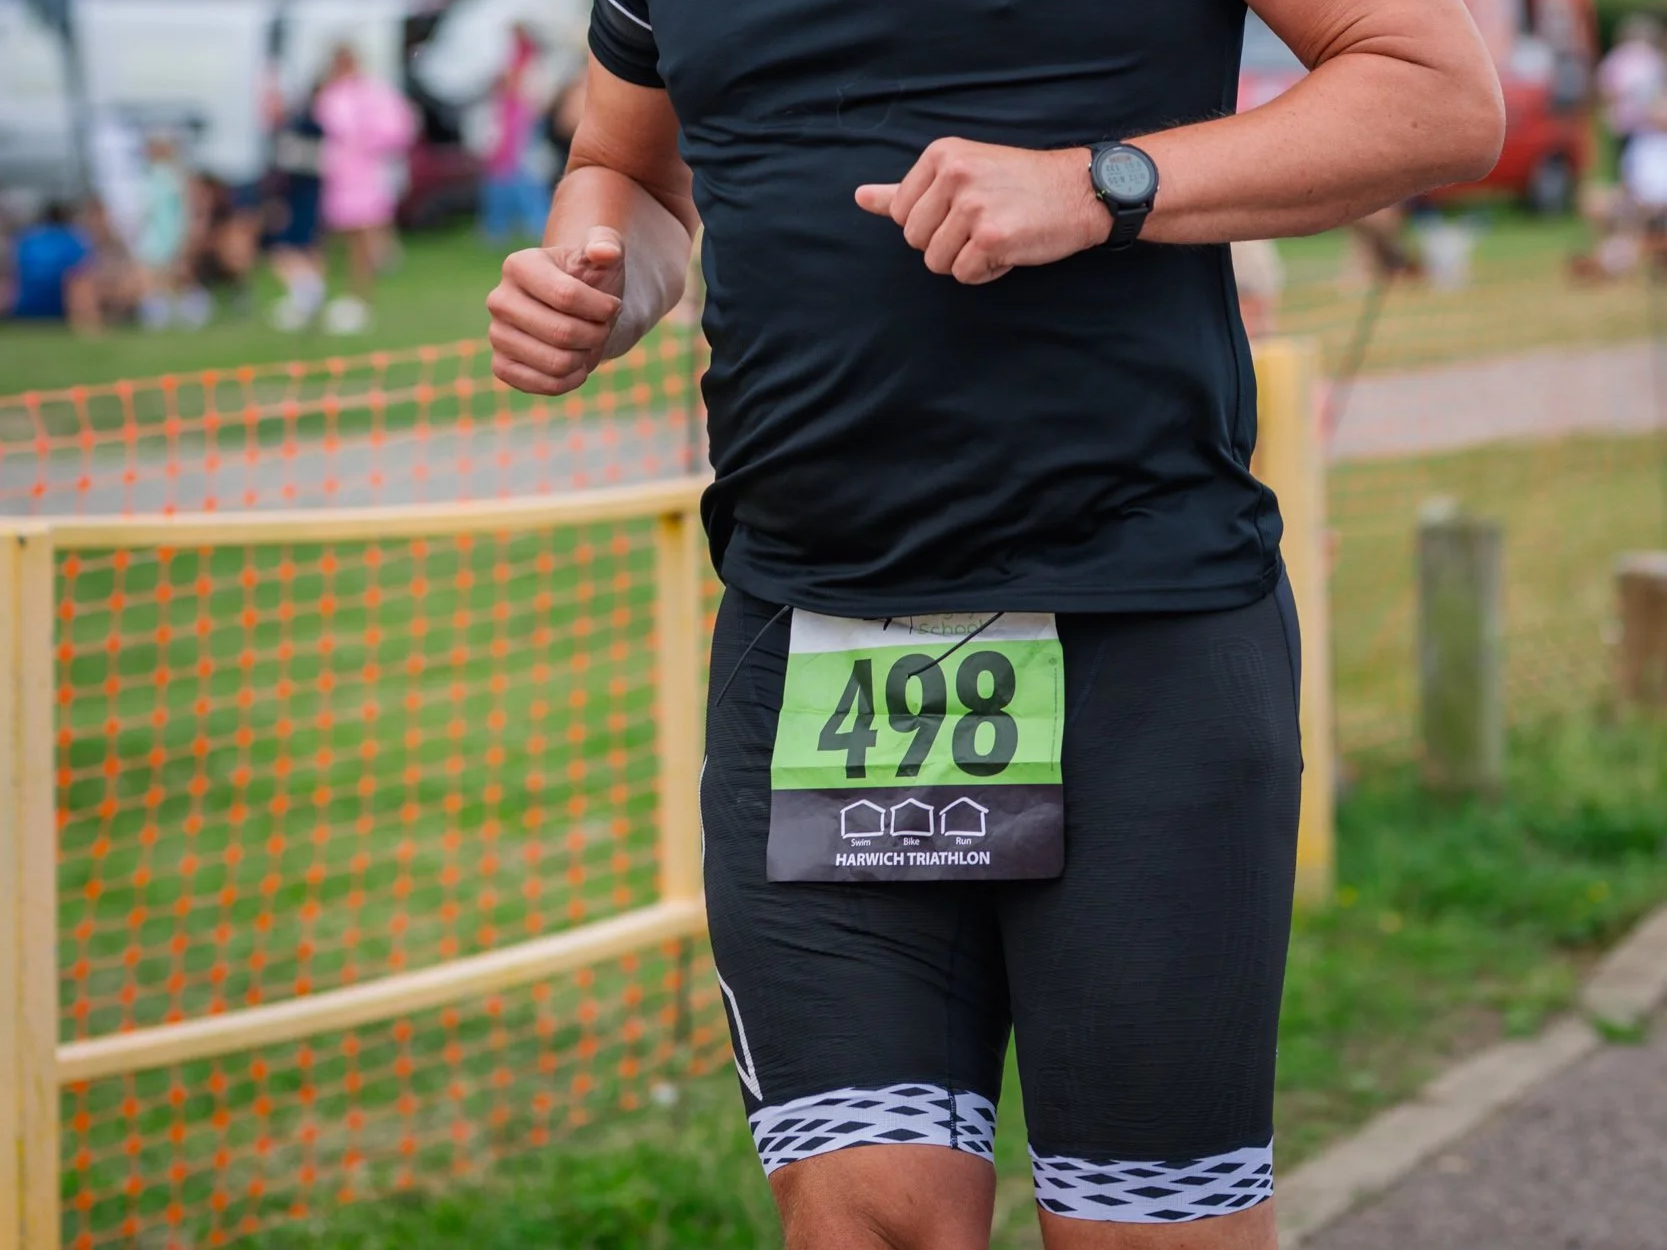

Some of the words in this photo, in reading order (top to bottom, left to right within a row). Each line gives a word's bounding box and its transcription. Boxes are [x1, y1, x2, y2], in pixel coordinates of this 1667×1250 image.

[817, 651, 1018, 779] 498
[850, 838, 871, 847] Swim
[903, 837, 920, 846] Bike
[955, 836, 972, 845] Run
[835, 852, 904, 867] HARWICH
[907, 851, 991, 866] TRIATHLON
